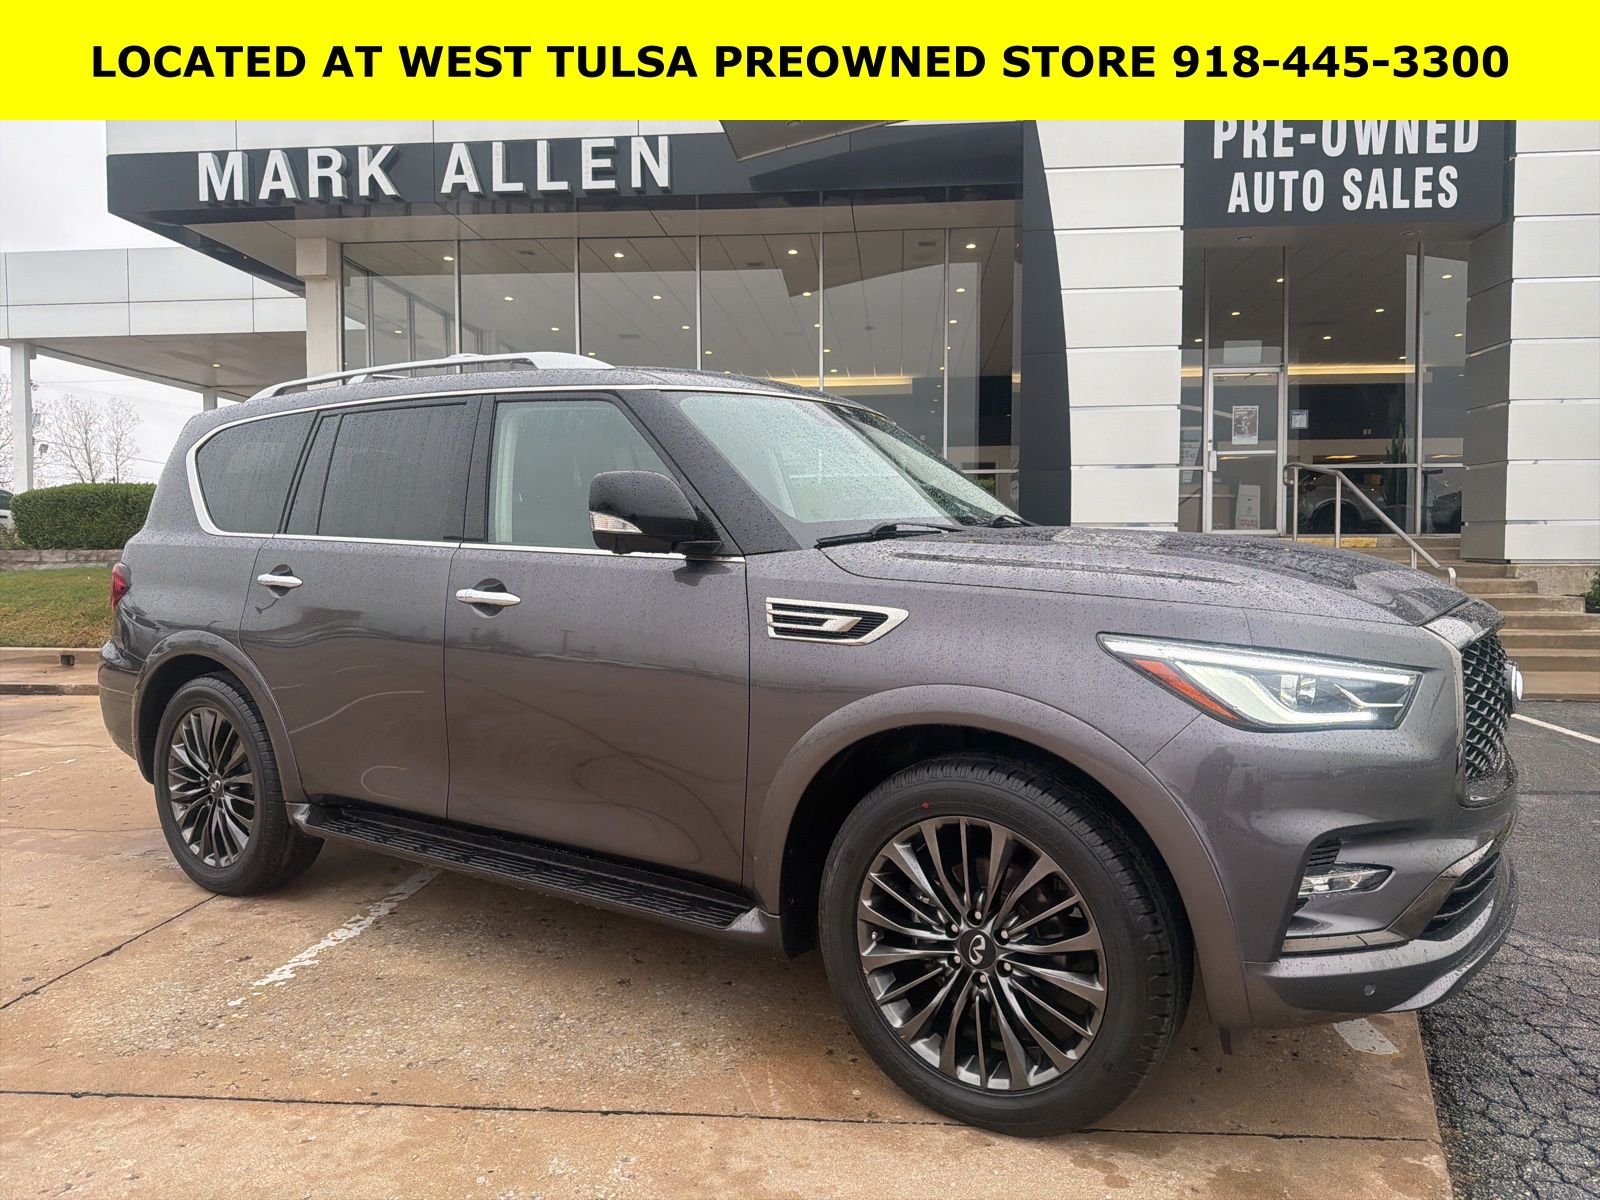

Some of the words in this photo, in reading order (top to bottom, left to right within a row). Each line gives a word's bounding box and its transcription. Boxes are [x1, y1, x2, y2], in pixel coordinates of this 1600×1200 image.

[1213, 120, 1479, 159] PRE-OWNED
[198, 145, 400, 202] MARK
[440, 136, 671, 195] ALLEN
[1227, 168, 1325, 213] AUTO
[1342, 165, 1459, 211] SALES
